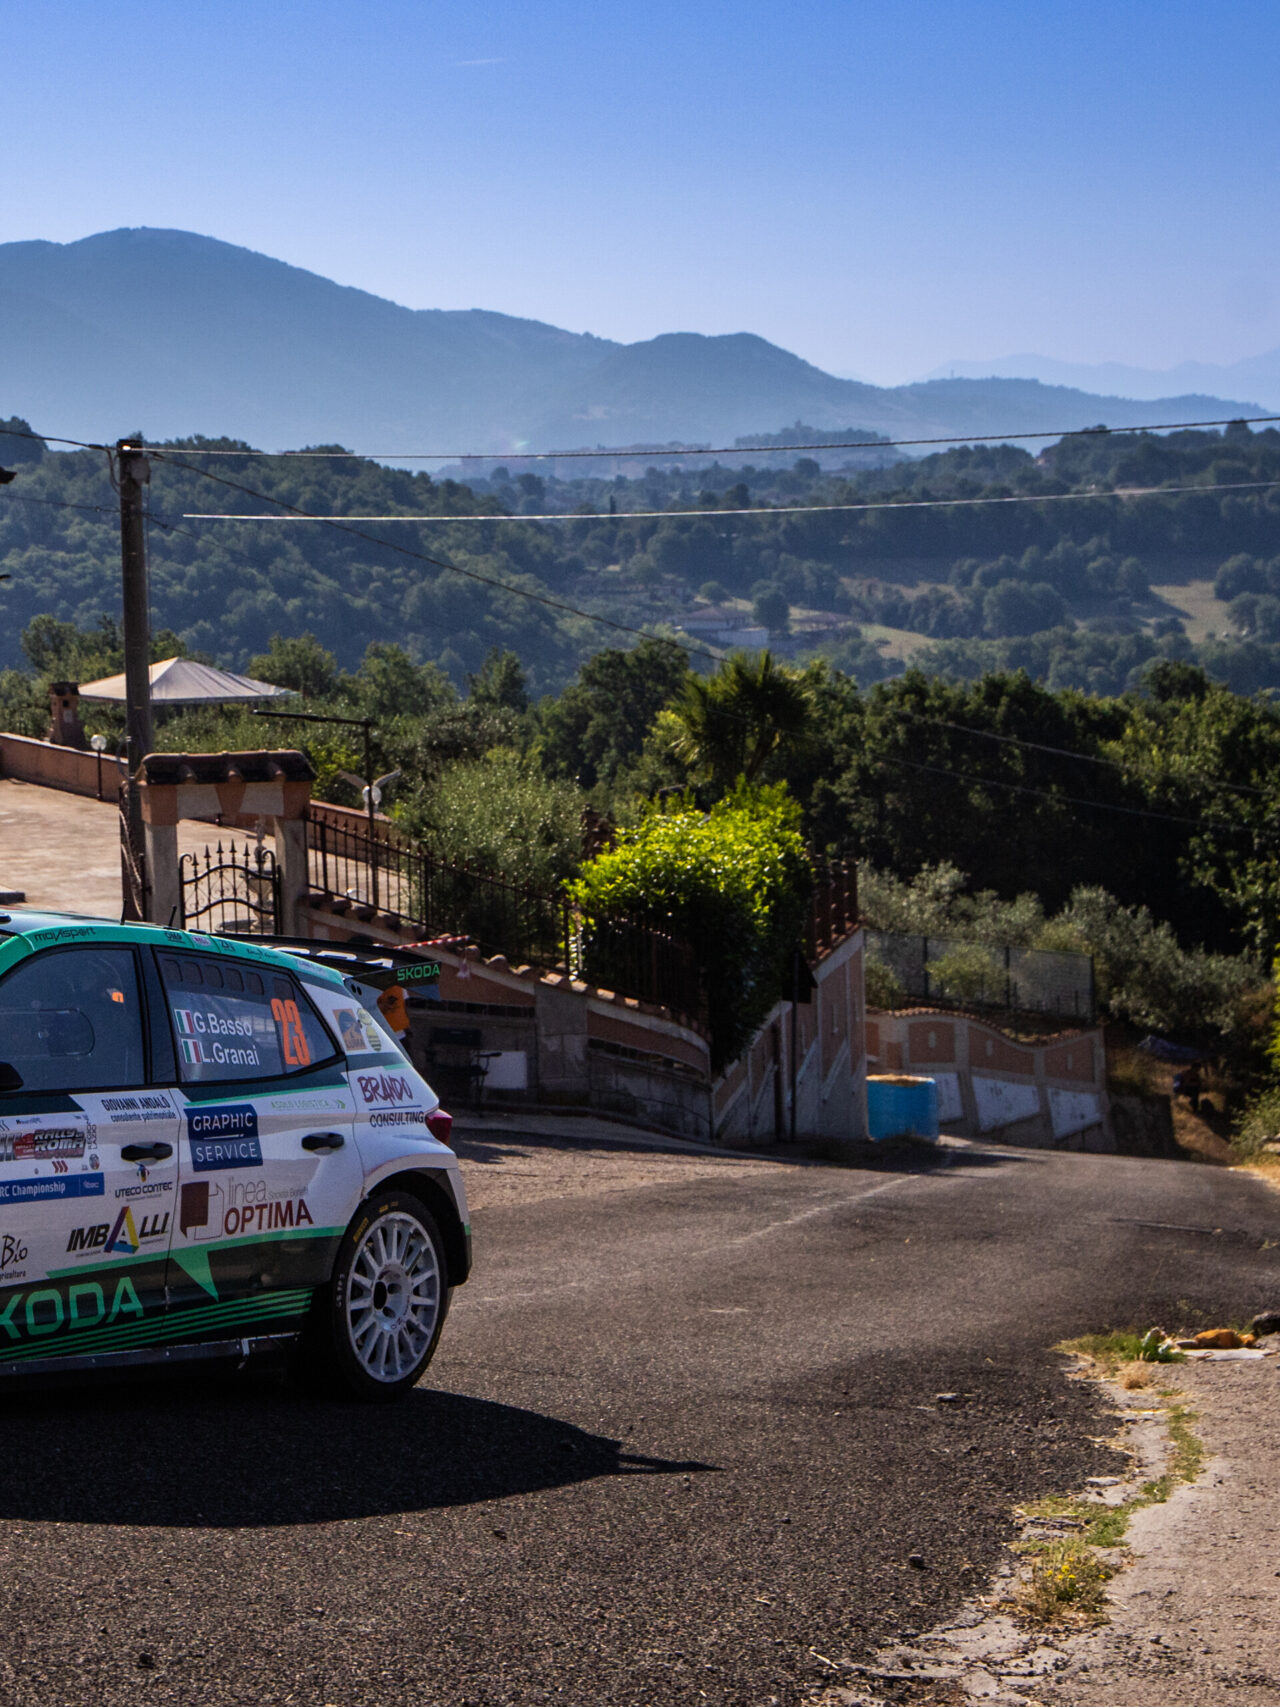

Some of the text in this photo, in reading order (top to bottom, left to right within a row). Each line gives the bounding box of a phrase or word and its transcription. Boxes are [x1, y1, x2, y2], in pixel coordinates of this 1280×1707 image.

[194, 1013, 252, 1036] G.Basso
[271, 999, 311, 1067] 23
[201, 1041, 260, 1066] L.Granai
[101, 1094, 171, 1111] GIOVANNI ANDALÒ
[357, 1074, 414, 1108] BRANDO
[193, 1112, 254, 1132] GRAPHIC
[370, 1110, 425, 1128] CONSULTING
[34, 1139, 84, 1151] ROMA
[35, 1128, 77, 1139] RALLY
[196, 1142, 258, 1163] SERVICE
[11, 1182, 66, 1196] Championship
[228, 1176, 267, 1206] linea
[224, 1199, 314, 1236] OPTIMA
[66, 1206, 170, 1254] IMBALLI
[0, 1233, 28, 1269] Bio
